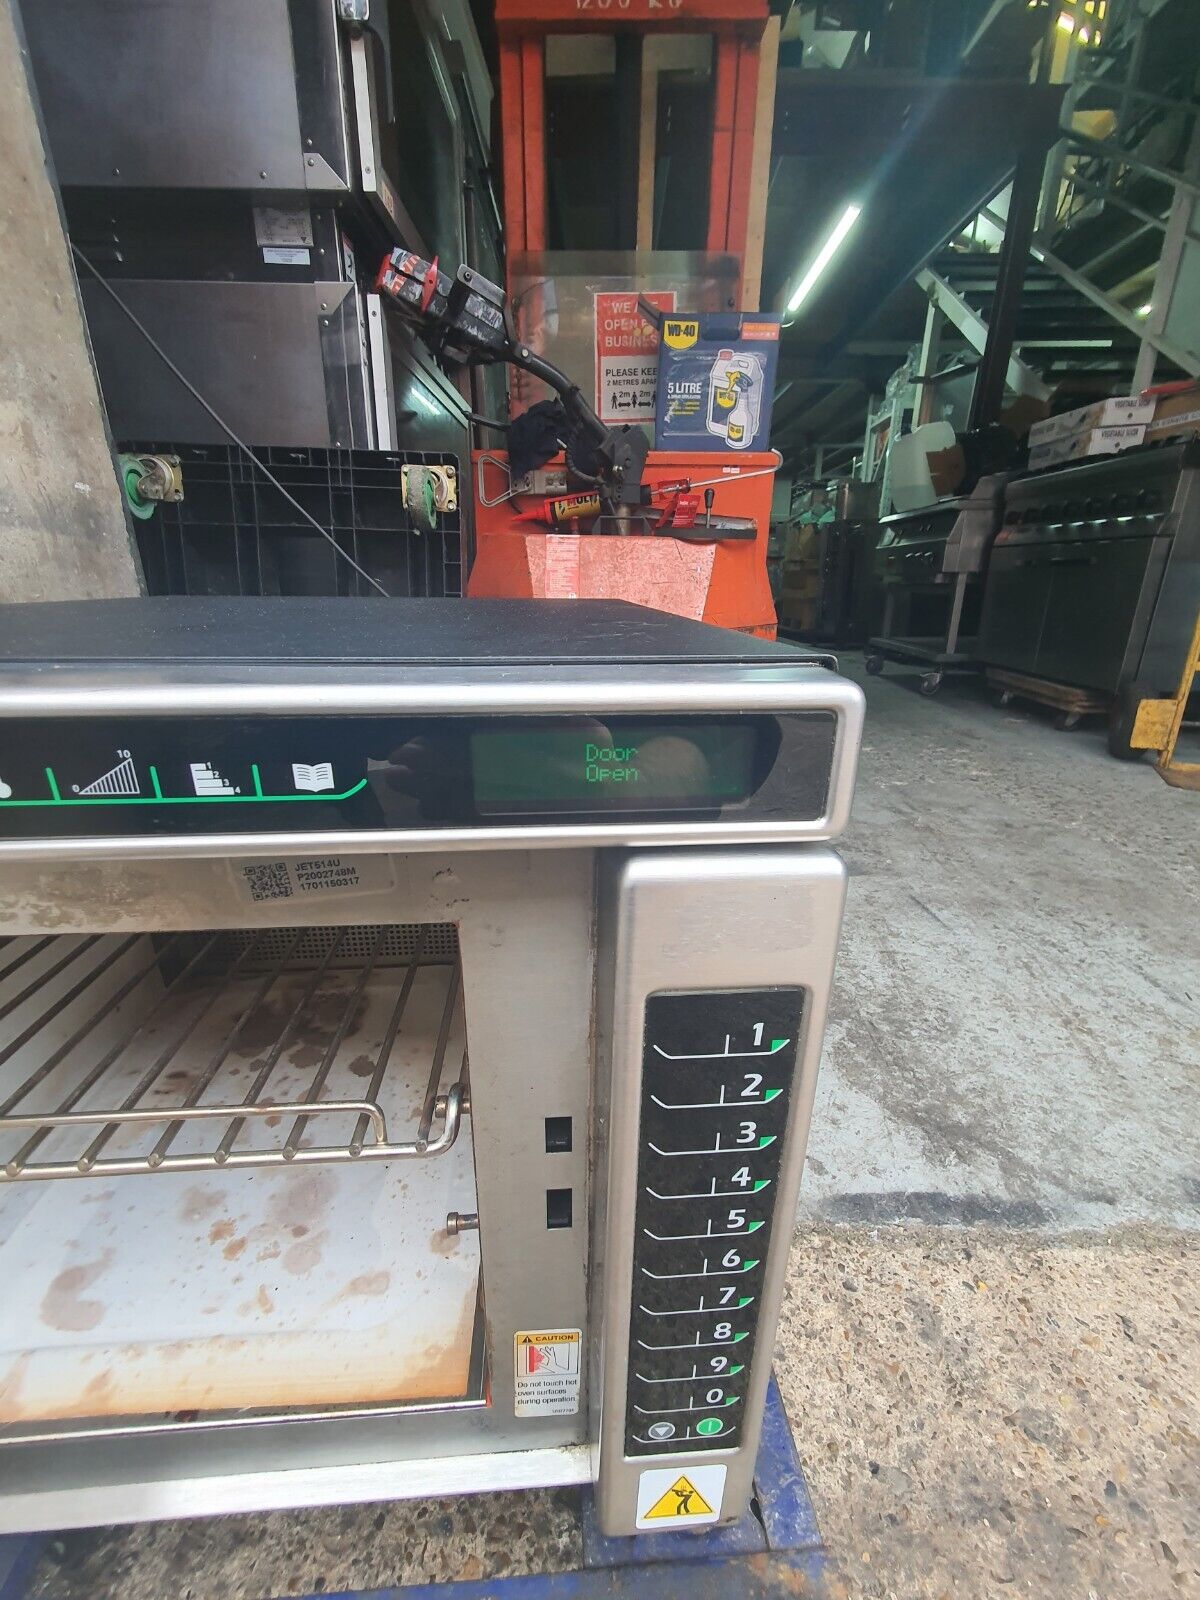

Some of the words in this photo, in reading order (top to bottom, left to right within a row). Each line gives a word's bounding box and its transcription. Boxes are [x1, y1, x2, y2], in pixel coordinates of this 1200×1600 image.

[611, 301, 631, 313] WE
[604, 318, 638, 331] OPEN
[668, 323, 696, 337] WD-40
[605, 335, 658, 348] BUSINES
[605, 368, 639, 377] PLEASE
[641, 367, 658, 376] KEE
[639, 390, 651, 398] 2m
[667, 382, 674, 393] 5
[676, 382, 703, 393] LITRE
[116, 750, 131, 758] 10
[586, 743, 639, 761] Door
[207, 762, 212, 770] 1
[586, 764, 639, 781] Open
[72, 784, 80, 793] 0
[235, 786, 241, 794] 4
[294, 859, 341, 871] JET514U
[297, 866, 356, 880] P2002748M
[300, 877, 359, 890] 1701150317
[753, 1022, 765, 1046] 1
[740, 1073, 763, 1097] 2
[736, 1121, 757, 1143] 3
[731, 1166, 751, 1187] 4
[726, 1209, 746, 1229] 5
[722, 1249, 741, 1267] 6
[718, 1286, 736, 1304] 7
[713, 1322, 732, 1339] 8
[535, 1334, 574, 1342] CAUTION
[710, 1356, 728, 1373] 9
[530, 1380, 541, 1388] not
[543, 1379, 564, 1387] touch
[537, 1388, 567, 1396] surfaces
[706, 1388, 723, 1404] 0
[542, 1396, 576, 1405] operation
